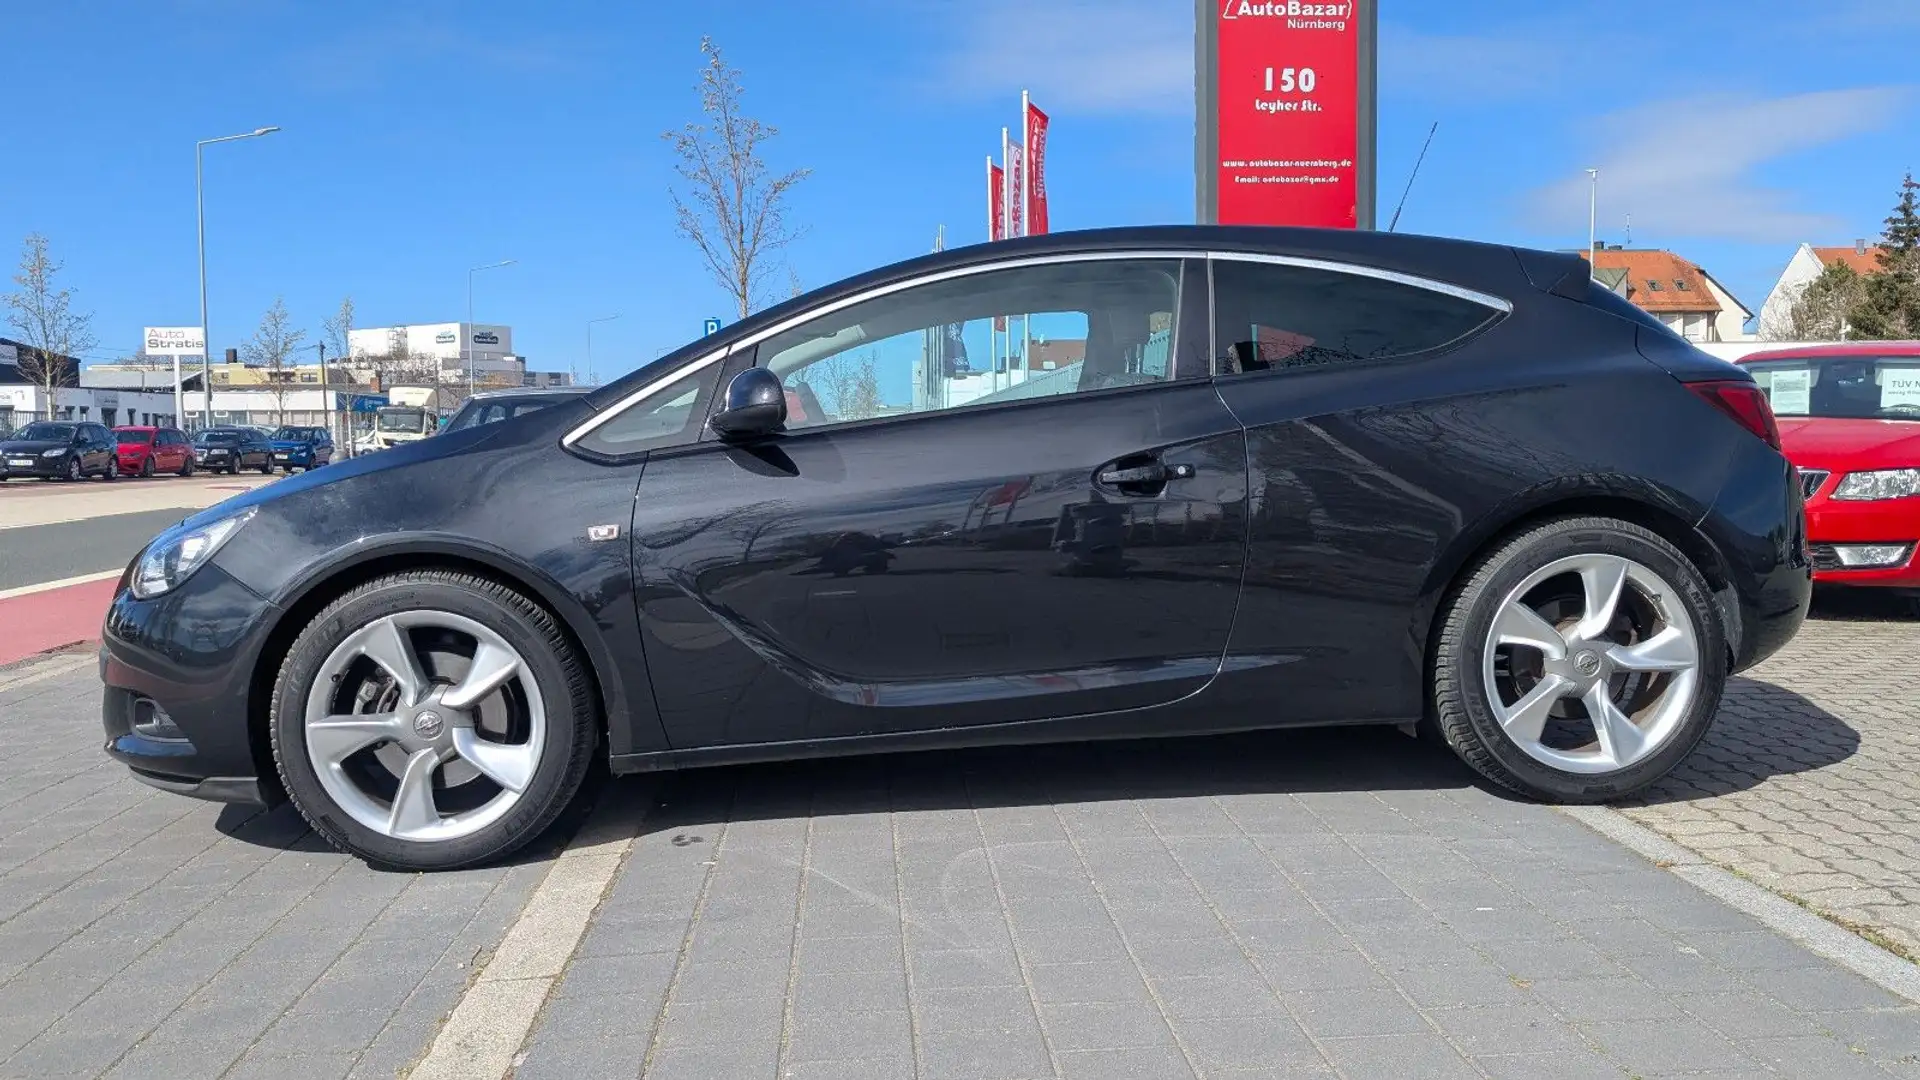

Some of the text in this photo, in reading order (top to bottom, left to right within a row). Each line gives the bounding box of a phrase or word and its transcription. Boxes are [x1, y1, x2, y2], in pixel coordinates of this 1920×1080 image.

[1238, 0, 1347, 16] AutoBazar
[1288, 19, 1345, 31] Nürnberg
[1265, 67, 1316, 92] 150
[1301, 99, 1323, 112] Str.
[148, 328, 185, 338] Auto
[707, 321, 718, 335] P
[147, 338, 204, 348] Stratis
